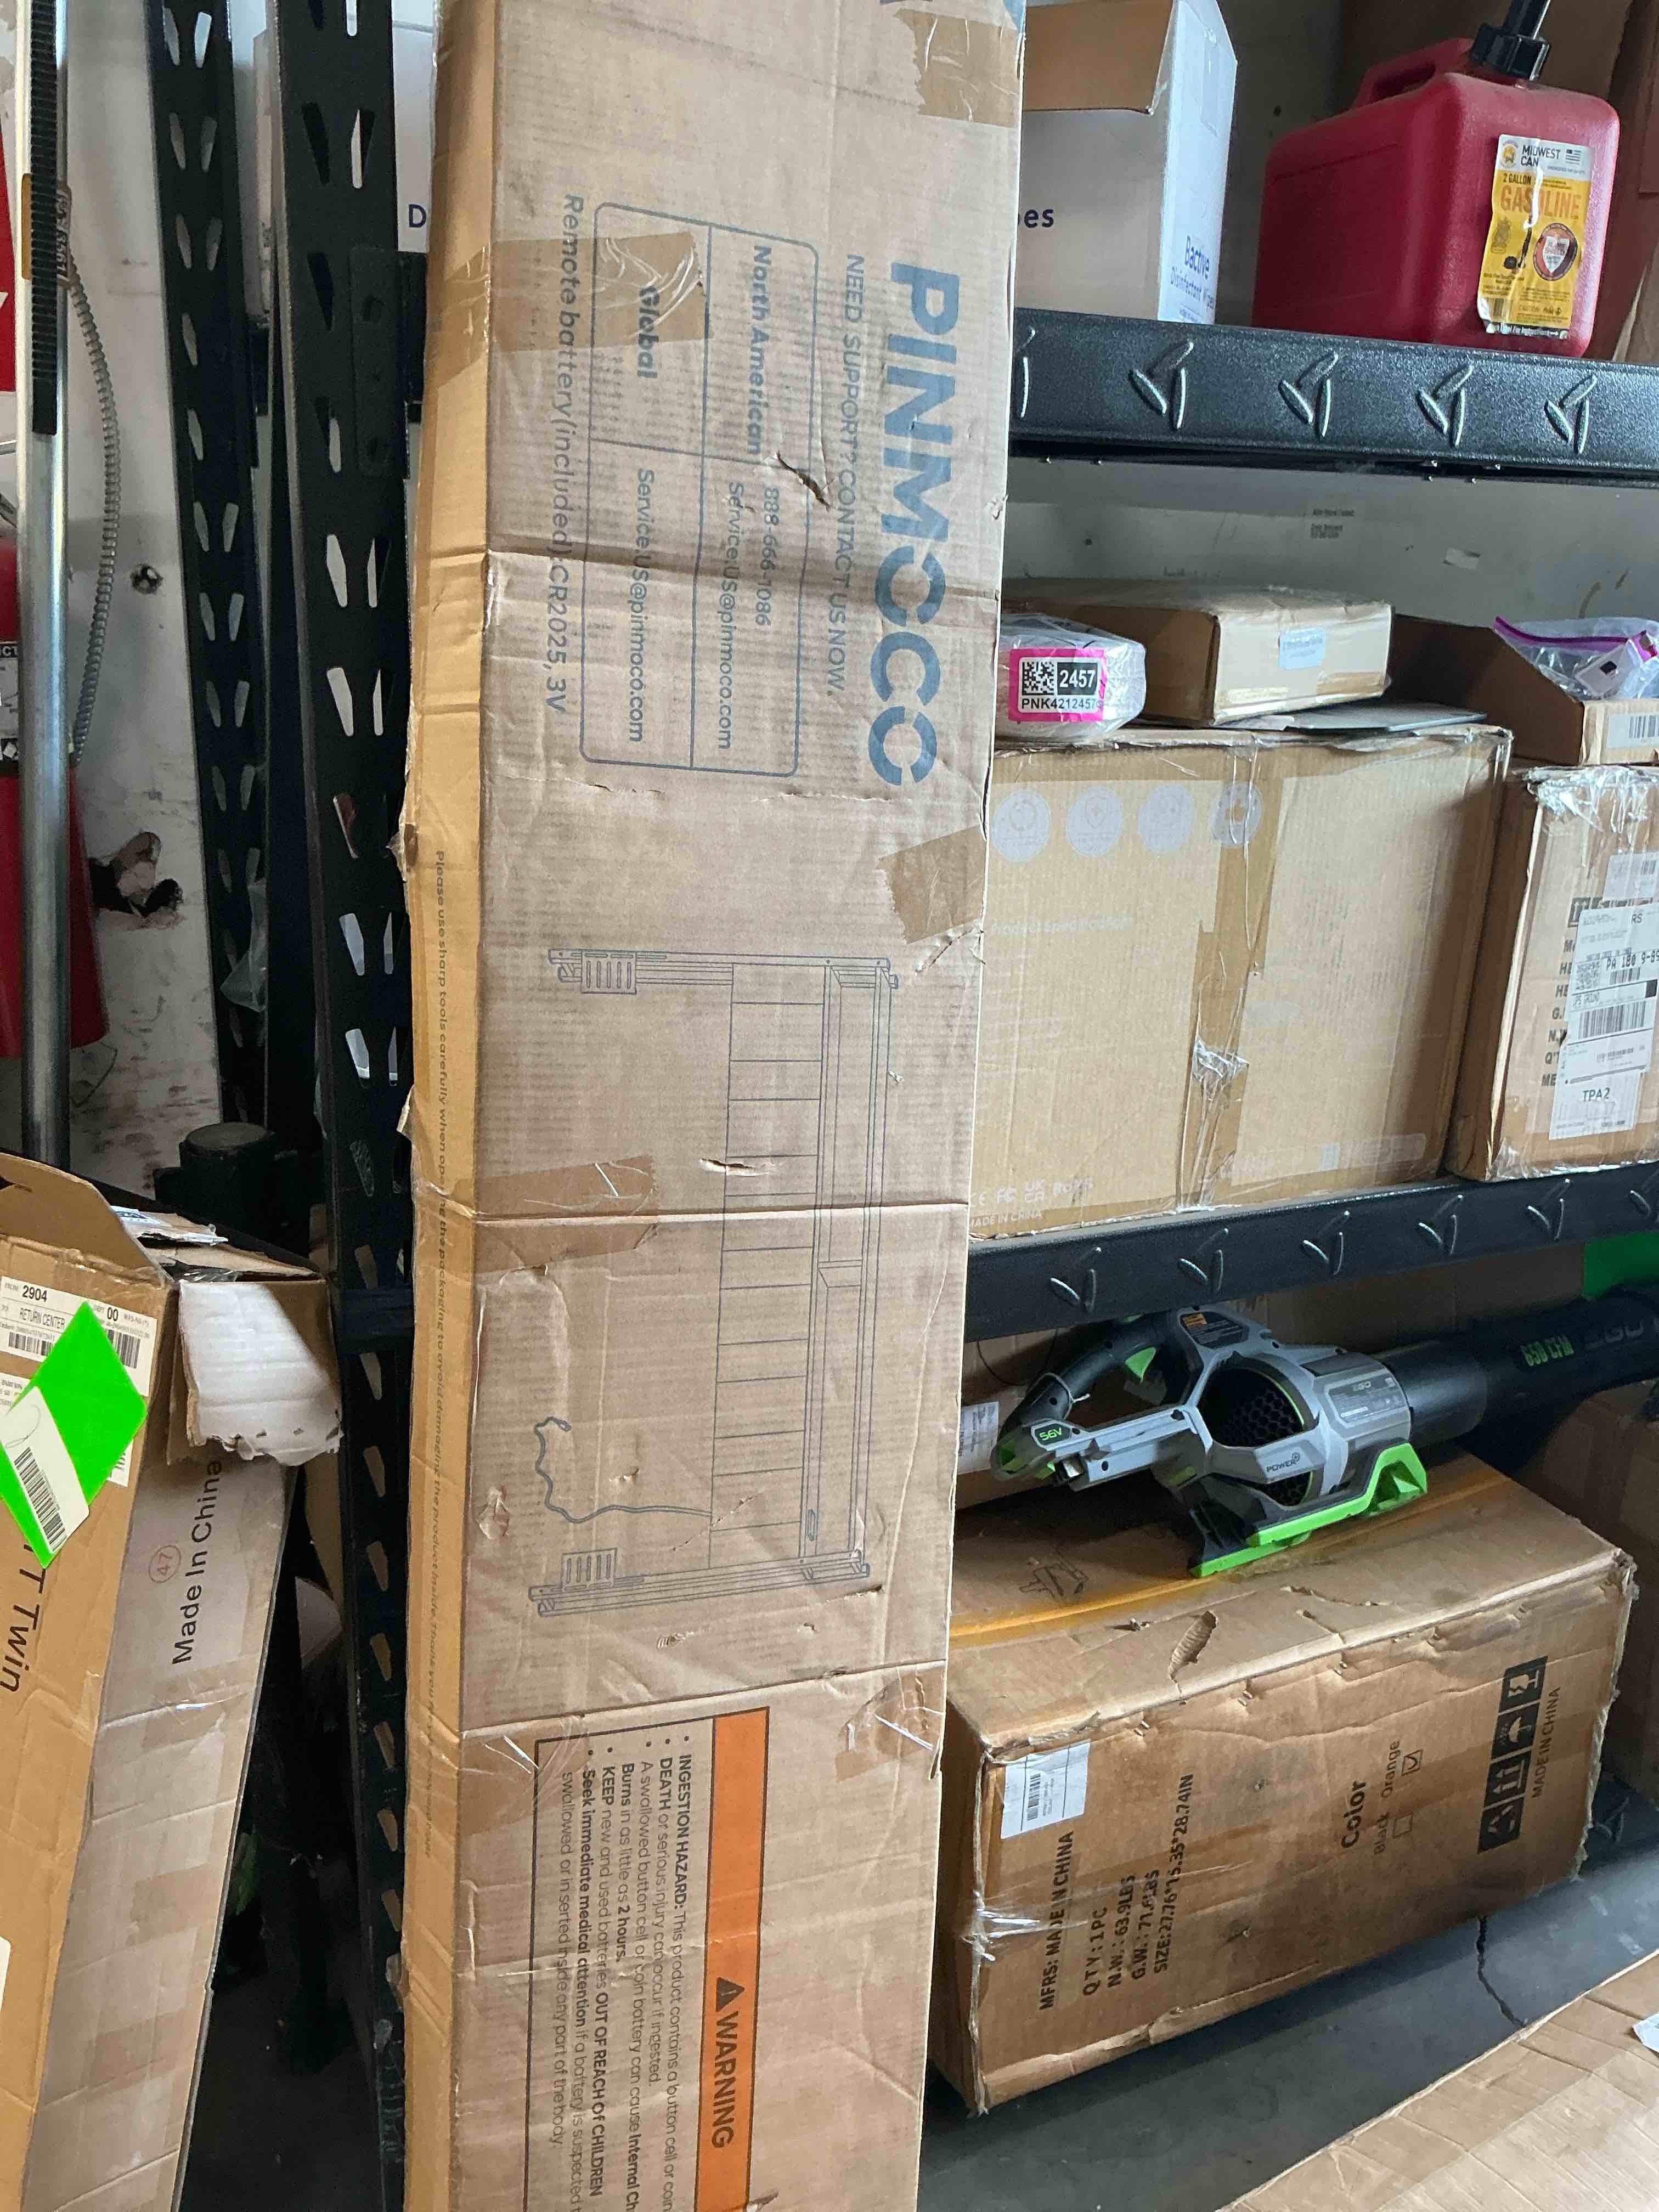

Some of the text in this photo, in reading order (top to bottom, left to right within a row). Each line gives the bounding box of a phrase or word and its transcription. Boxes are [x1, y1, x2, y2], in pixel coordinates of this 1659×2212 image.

[1521, 156, 1539, 167] CAN
[1522, 144, 1561, 159] MIDWEST
[1503, 173, 1508, 183] 2
[1509, 174, 1532, 185] GALLON
[558, 193, 584, 302] Remote
[1184, 235, 1210, 280] Bactive
[845, 255, 865, 324] NEED
[747, 245, 773, 455] North American
[840, 332, 862, 464] SUPPORT?
[833, 469, 857, 589] CONTACT
[868, 262, 961, 786] PINMOCO
[754, 486, 781, 626] 888-666-1086
[828, 592, 850, 624] US
[546, 678, 568, 714] 3V
[1060, 669, 1095, 688] 2457
[436, 851, 445, 905] Please
[438, 940, 448, 986] sharp
[439, 991, 448, 1030] tools
[438, 1034, 448, 1105] carefully
[1582, 1087, 1610, 1102] TPA2
[439, 1109, 447, 1150] when
[438, 1155, 448, 1217] openg
[439, 1220, 447, 1245] the
[22, 1285, 47, 1302] 2904
[107, 1307, 119, 1321] 00
[437, 1249, 447, 1331] packaging
[20, 1308, 42, 1325] RETURN
[42, 1311, 65, 1329] CENTER
[438, 1335, 444, 1348] to
[434, 1400, 444, 1476] damaging
[1039, 1426, 1062, 1441] 56V
[172, 1459, 222, 1664] Made In China
[0, 1604, 41, 1693] Twin
[1532, 1686, 1561, 1798] MADE IN CHINA
[602, 1766, 615, 1805] KEEP
[640, 1761, 653, 1773] A
[658, 1757, 673, 1810] DEATH
[1381, 1740, 1401, 1798] Orange
[561, 1772, 575, 1854] swallowed
[637, 1776, 652, 1858] swallowed
[677, 1754, 692, 1838] INGESTION
[1341, 1781, 1366, 1848] Color
[601, 1810, 612, 1843] new
[659, 1814, 670, 1827] or
[561, 1859, 571, 1875] or
[600, 1847, 613, 1876] and
[616, 1763, 634, 1962] Burns in as little as 2 hours.
[656, 1833, 669, 1884] serious
[674, 1841, 688, 1910] HAZARD:
[1053, 1830, 1074, 1887] CHINA
[599, 1881, 612, 1917] used
[636, 1861, 651, 1912] button
[652, 1888, 668, 1928] injury
[1052, 1888, 1068, 1908] IN
[635, 1917, 649, 1941] cell
[653, 1932, 664, 1960] can
[673, 1911, 686, 1940] This
[556, 1946, 571, 1991] inside
[595, 1922, 611, 1989] batteries
[635, 1945, 647, 1960] or
[670, 1945, 684, 2002] product
[570, 1769, 595, 2203] Seek immediate medical attention if a battery is suspected
[652, 1965, 664, 2005] occur
[1040, 1958, 1059, 2010] MFRS:
[553, 1995, 567, 2021] any
[595, 1993, 609, 2023] OUT
[629, 1999, 646, 2052] battery
[652, 2010, 664, 2019] if
[553, 2025, 566, 2057] part
[594, 2026, 607, 2046] OF
[668, 2007, 681, 2068] contains
[554, 2060, 567, 2075] of
[592, 2050, 607, 2099] REACH
[630, 2057, 642, 2083] can
[668, 2072, 678, 2082] a
[711, 2010, 740, 2148] WARNING
[554, 2079, 566, 2102] the
[628, 2087, 641, 2132] cause
[665, 2084, 680, 2134] button
[589, 2124, 605, 2197] CHILDREN
[627, 2135, 641, 2189] Internal
[664, 2137, 678, 2162] cell
[664, 2164, 675, 2177] or
